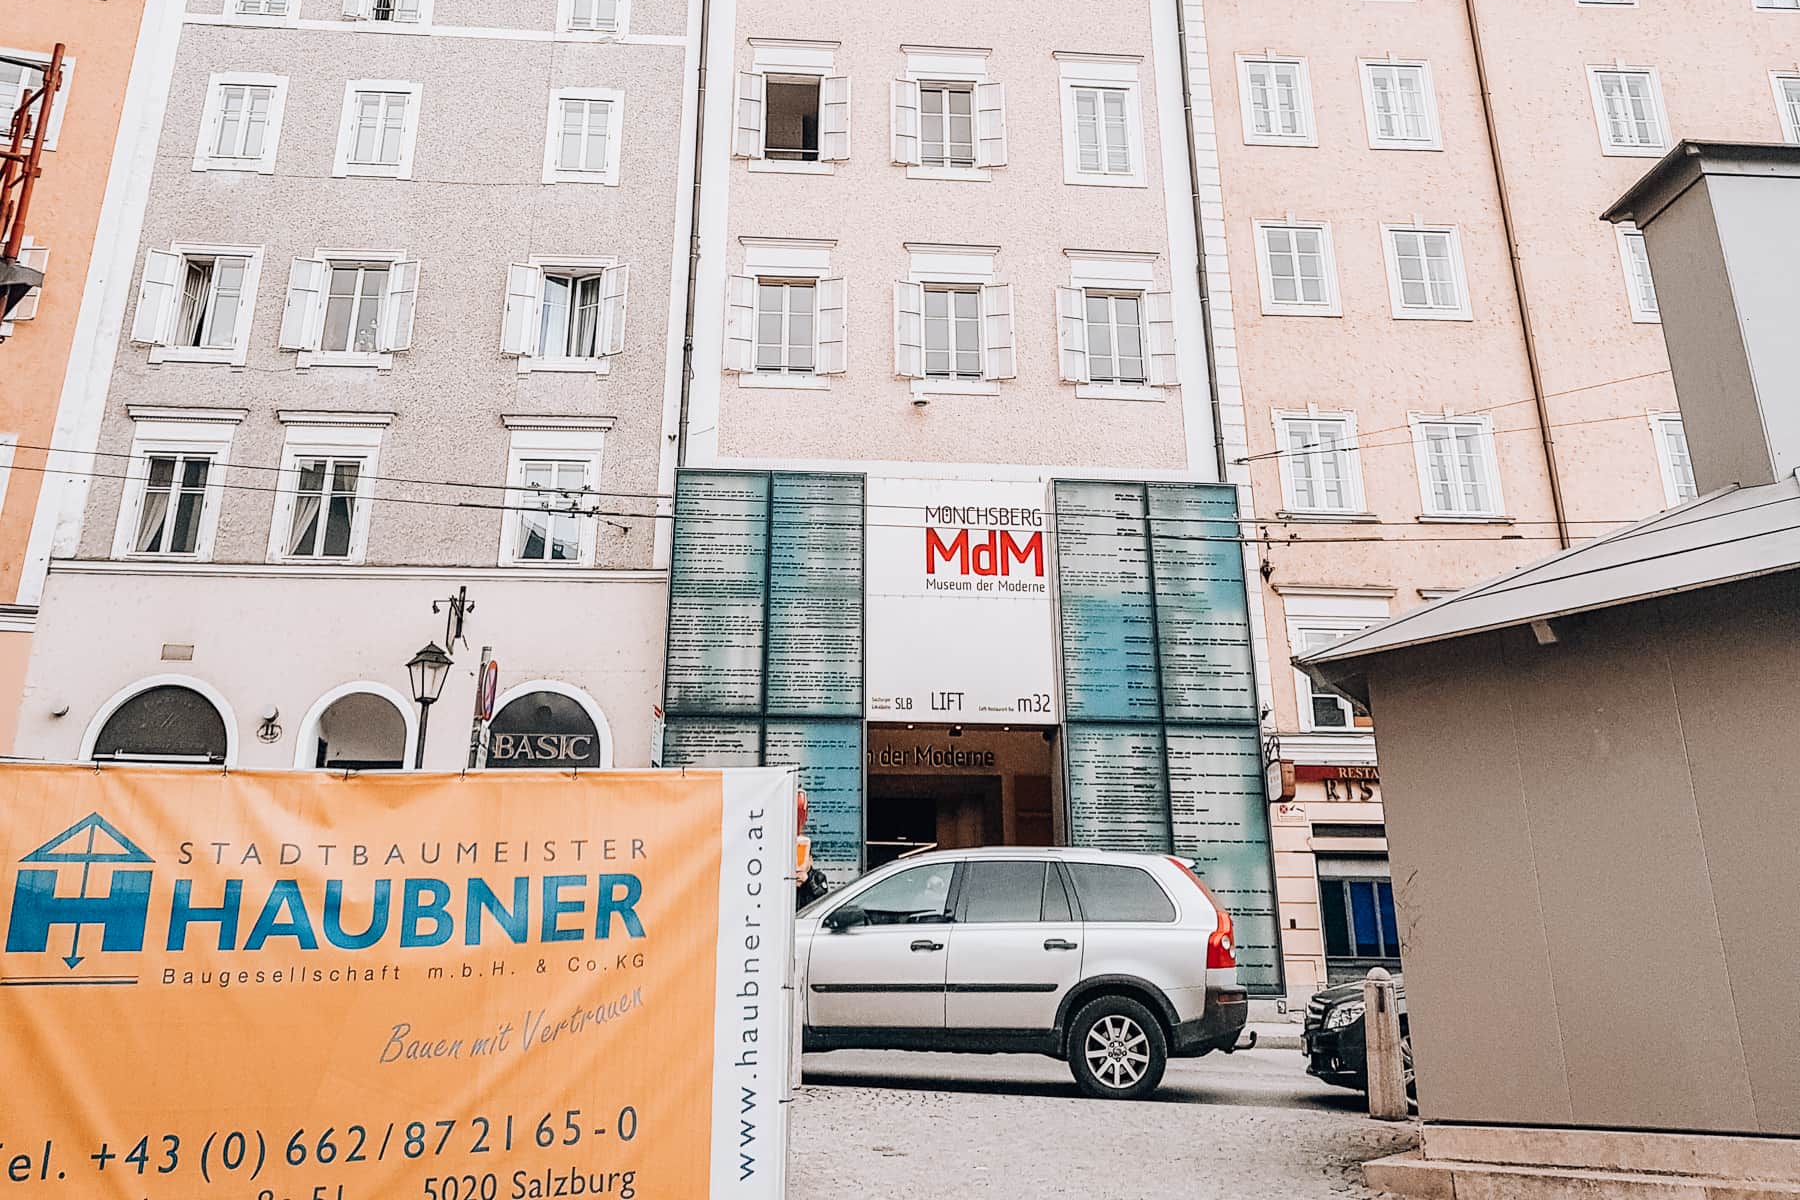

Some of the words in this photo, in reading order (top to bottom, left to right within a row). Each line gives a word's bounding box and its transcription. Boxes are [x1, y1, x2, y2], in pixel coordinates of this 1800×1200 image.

[926, 527, 1044, 577] MdM
[926, 578, 972, 591] Museum
[976, 579, 994, 592] der
[998, 580, 1045, 592] Moderne
[895, 697, 913, 710] SLB
[931, 691, 964, 711] LIFT
[1017, 693, 1051, 713] m32
[493, 734, 592, 760] BASIC
[880, 744, 908, 766] der
[914, 744, 995, 768] Moderne
[178, 838, 648, 866] STADTBAUMEISTER
[165, 872, 648, 952] HAUBNER
[162, 964, 401, 987] Baugesellschaft
[428, 961, 516, 979] m.b.H.
[536, 959, 547, 974] &
[734, 808, 764, 1182] www.haubner.co.at
[379, 1023, 464, 1065] Bauen
[469, 1025, 513, 1058] mit
[522, 986, 644, 1051] Vertrauen
[0, 1140, 66, 1182] el.
[90, 1134, 181, 1175] +43
[424, 1173, 498, 1200] 5020
[511, 1166, 636, 1200] Salzburg
